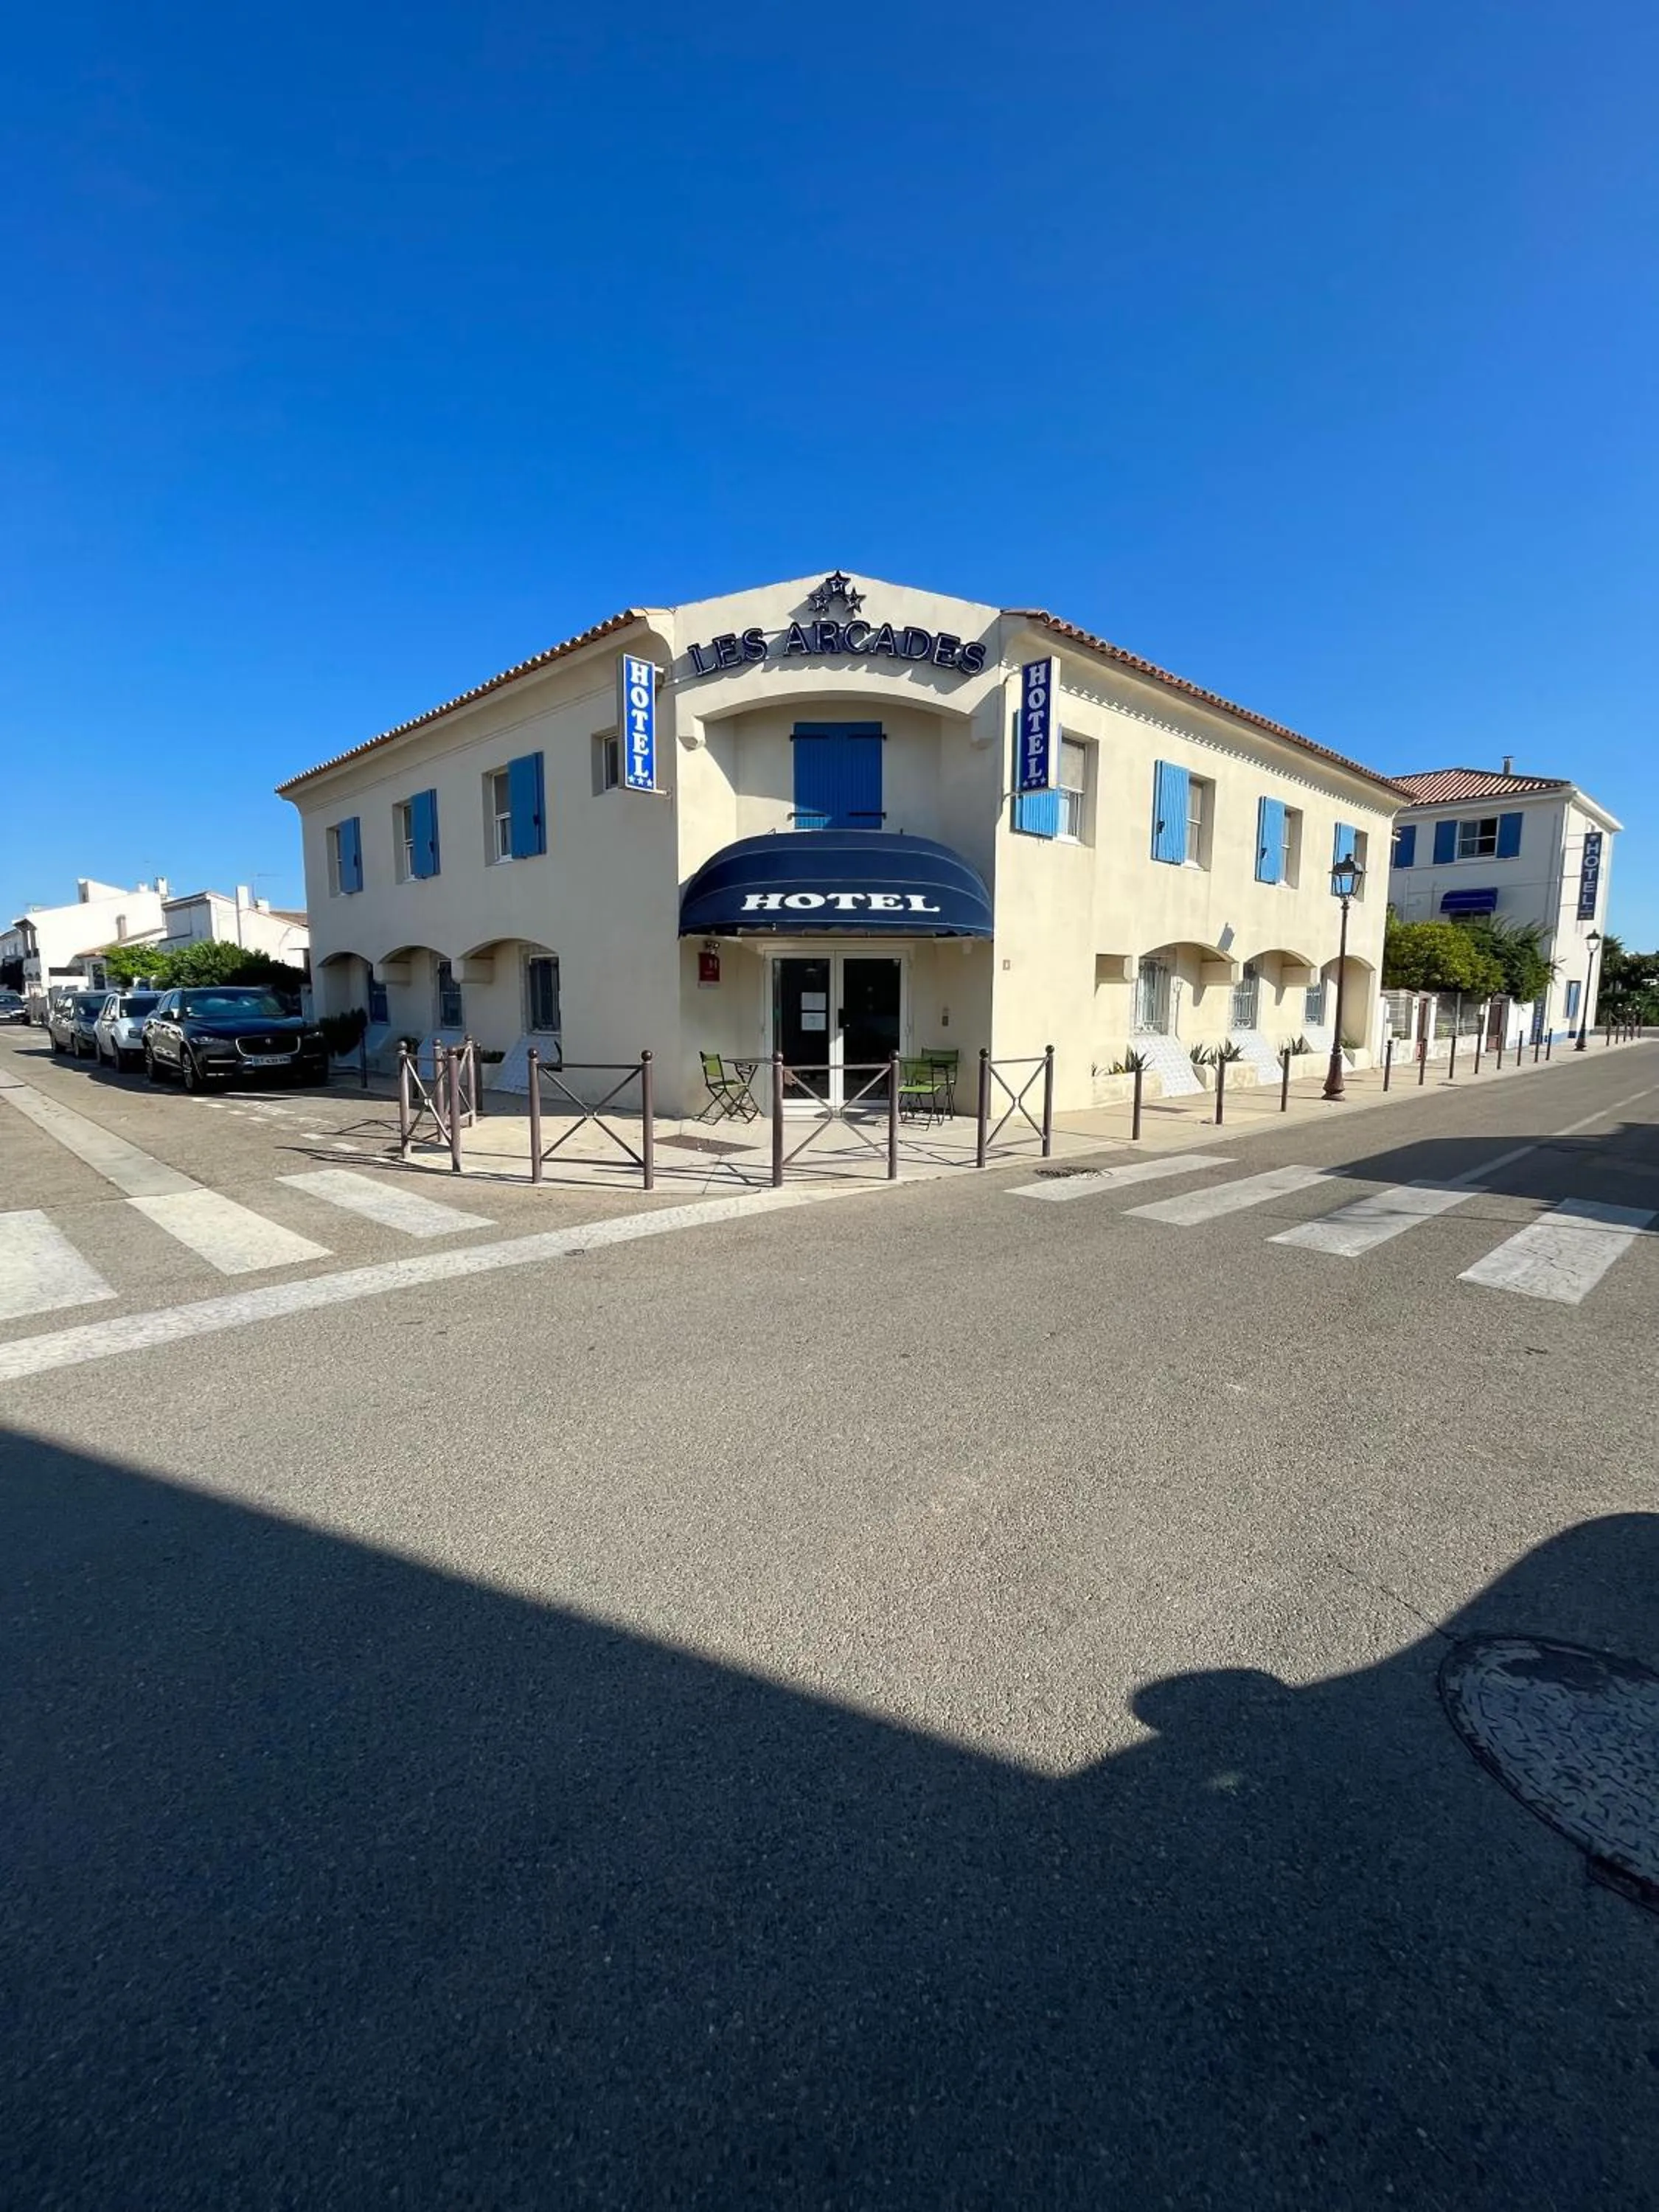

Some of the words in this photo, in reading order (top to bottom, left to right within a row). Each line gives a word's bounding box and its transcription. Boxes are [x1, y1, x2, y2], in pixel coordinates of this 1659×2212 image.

[687, 627, 768, 677] LES
[783, 620, 987, 674] ARCADES
[630, 661, 649, 778] HOTEL
[1027, 664, 1046, 779] HOTEL
[741, 893, 940, 912] HOTEL
[1582, 843, 1599, 905] HOTEL
